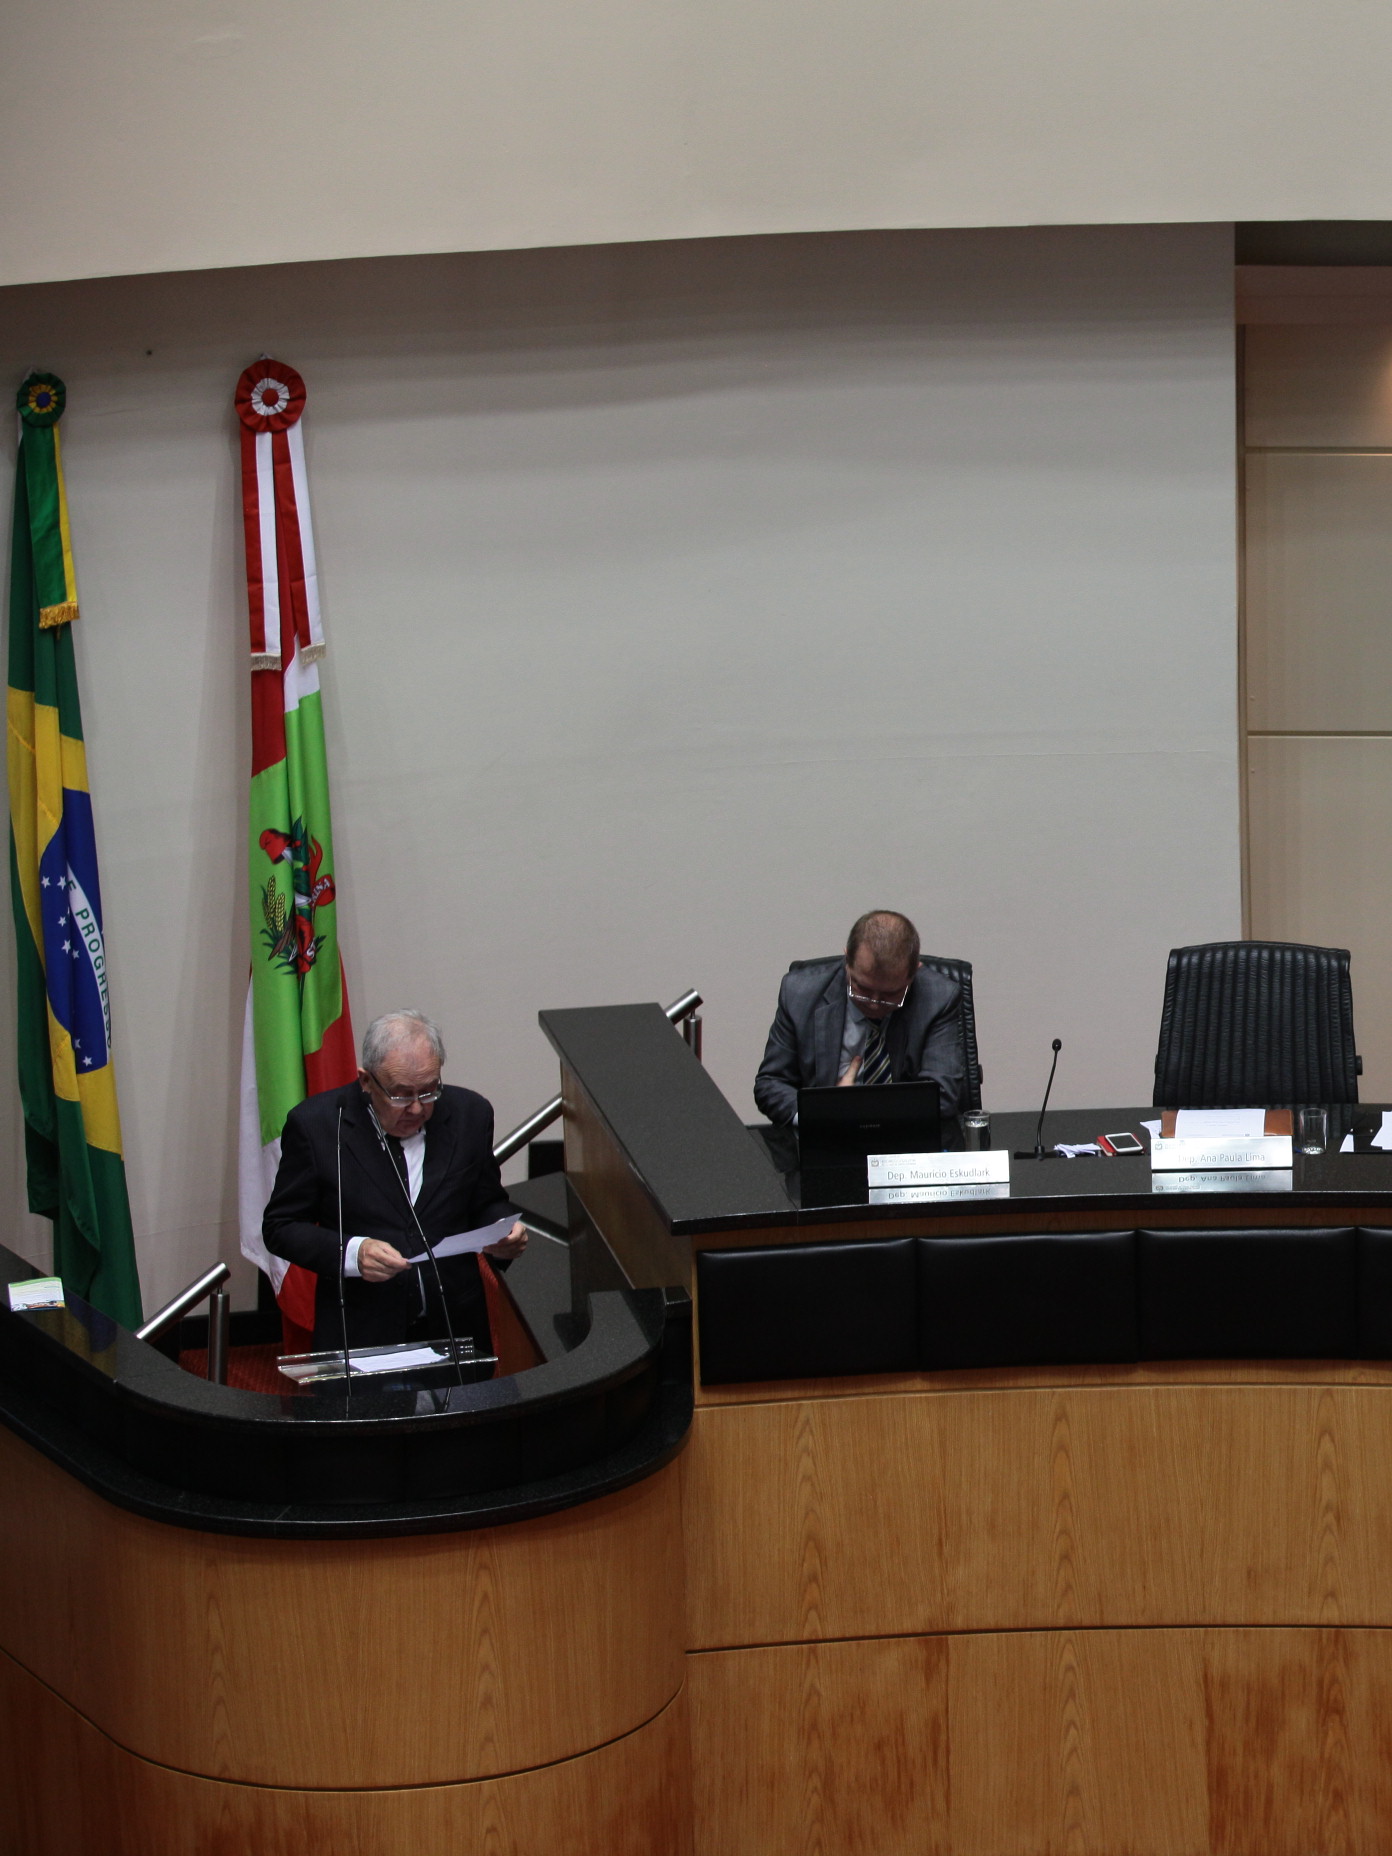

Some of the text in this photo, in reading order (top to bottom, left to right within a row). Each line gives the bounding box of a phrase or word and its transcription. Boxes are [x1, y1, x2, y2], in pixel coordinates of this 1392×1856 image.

[1200, 1153, 1217, 1163] Ana
[1219, 1152, 1243, 1163] Paula
[1245, 1151, 1266, 1162] Lima
[887, 1170, 907, 1182] Dep.
[949, 1167, 991, 1178] Eskudlark
